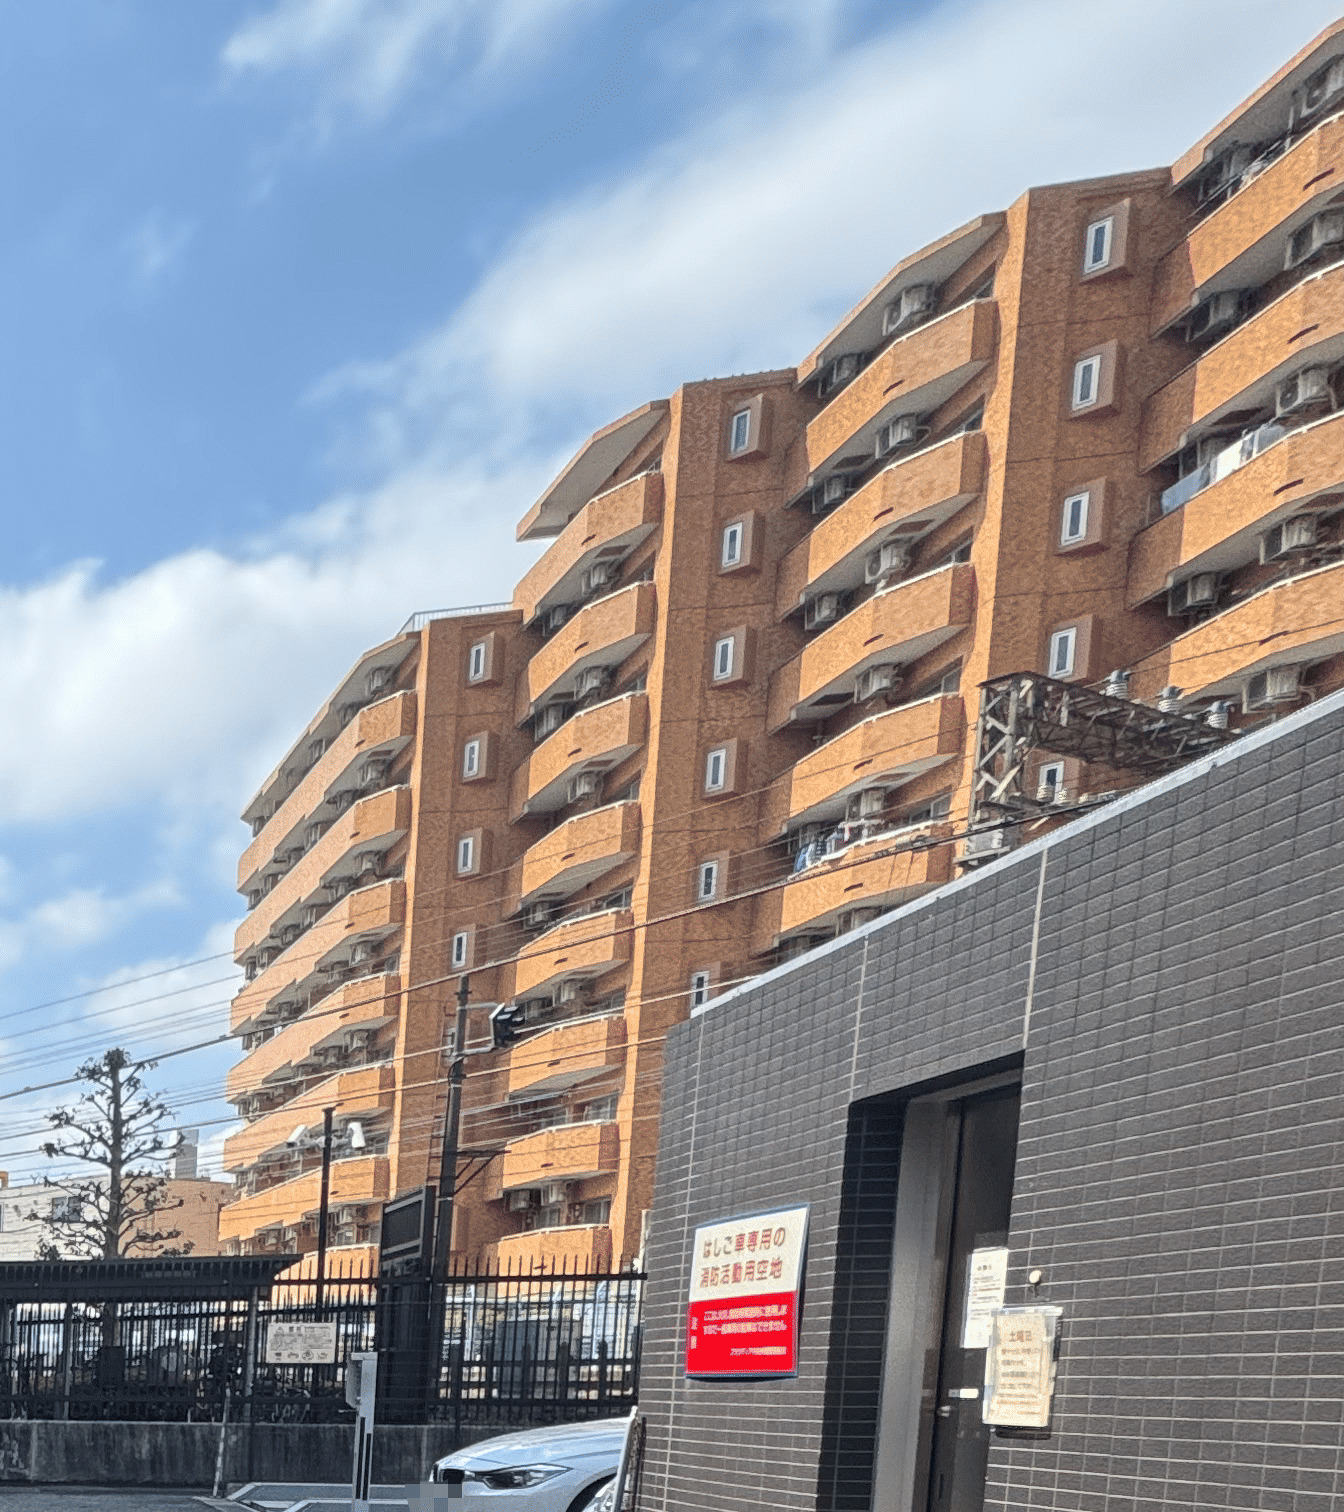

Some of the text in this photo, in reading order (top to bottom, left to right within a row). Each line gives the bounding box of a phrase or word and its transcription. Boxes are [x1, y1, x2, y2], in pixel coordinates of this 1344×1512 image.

[702, 1227, 786, 1259] はしご車専用の
[699, 1255, 783, 1289] 消防活動用空地
